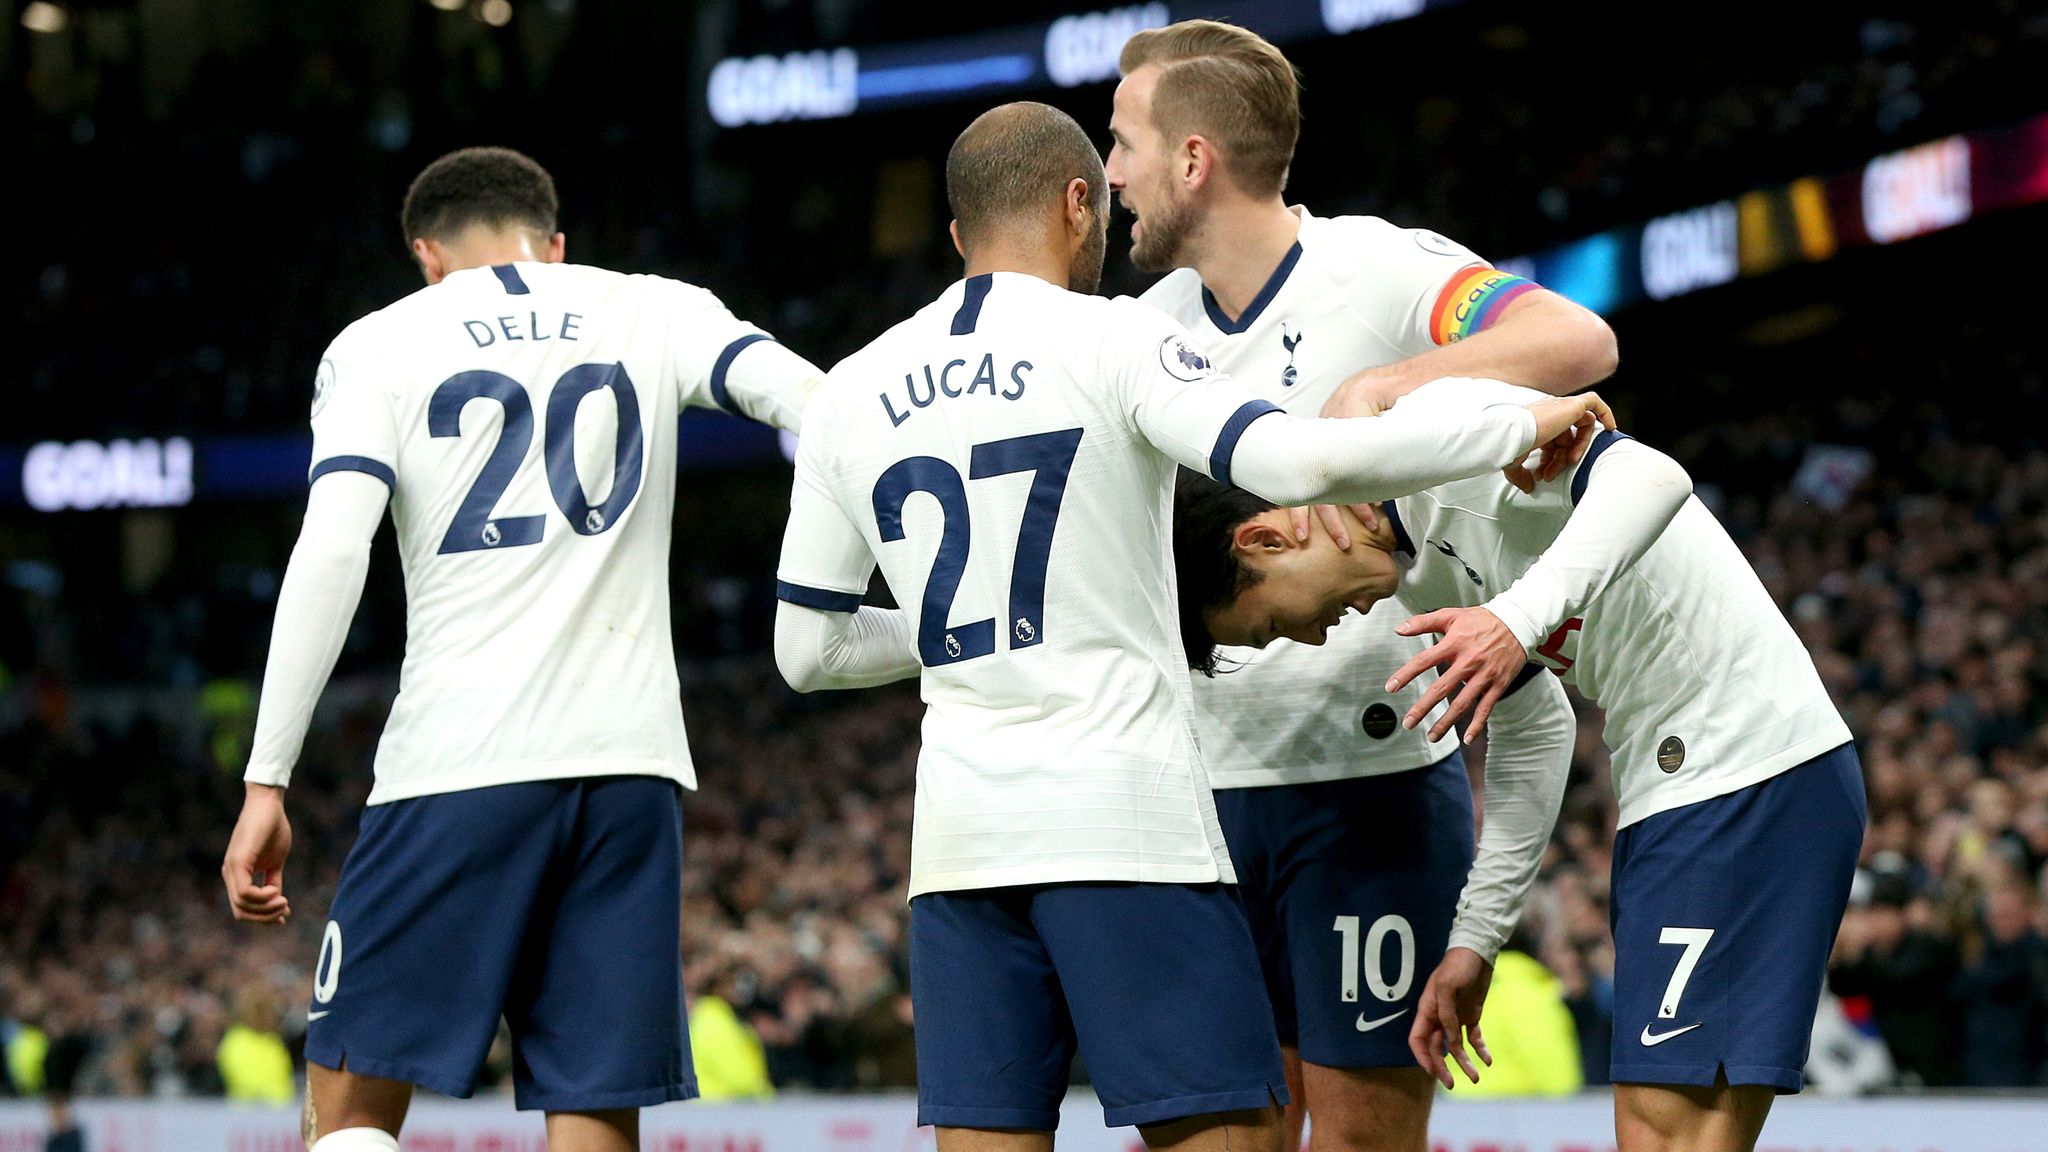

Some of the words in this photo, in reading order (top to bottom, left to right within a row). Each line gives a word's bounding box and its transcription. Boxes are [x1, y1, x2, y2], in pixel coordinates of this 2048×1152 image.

[463, 311, 583, 348] DELE
[1455, 273, 1505, 322] Cap
[880, 353, 1034, 428] LUCAS
[428, 361, 644, 556] 20
[872, 427, 1085, 668] 27
[1333, 914, 1415, 1002] 10
[1658, 927, 1715, 1019] 7
